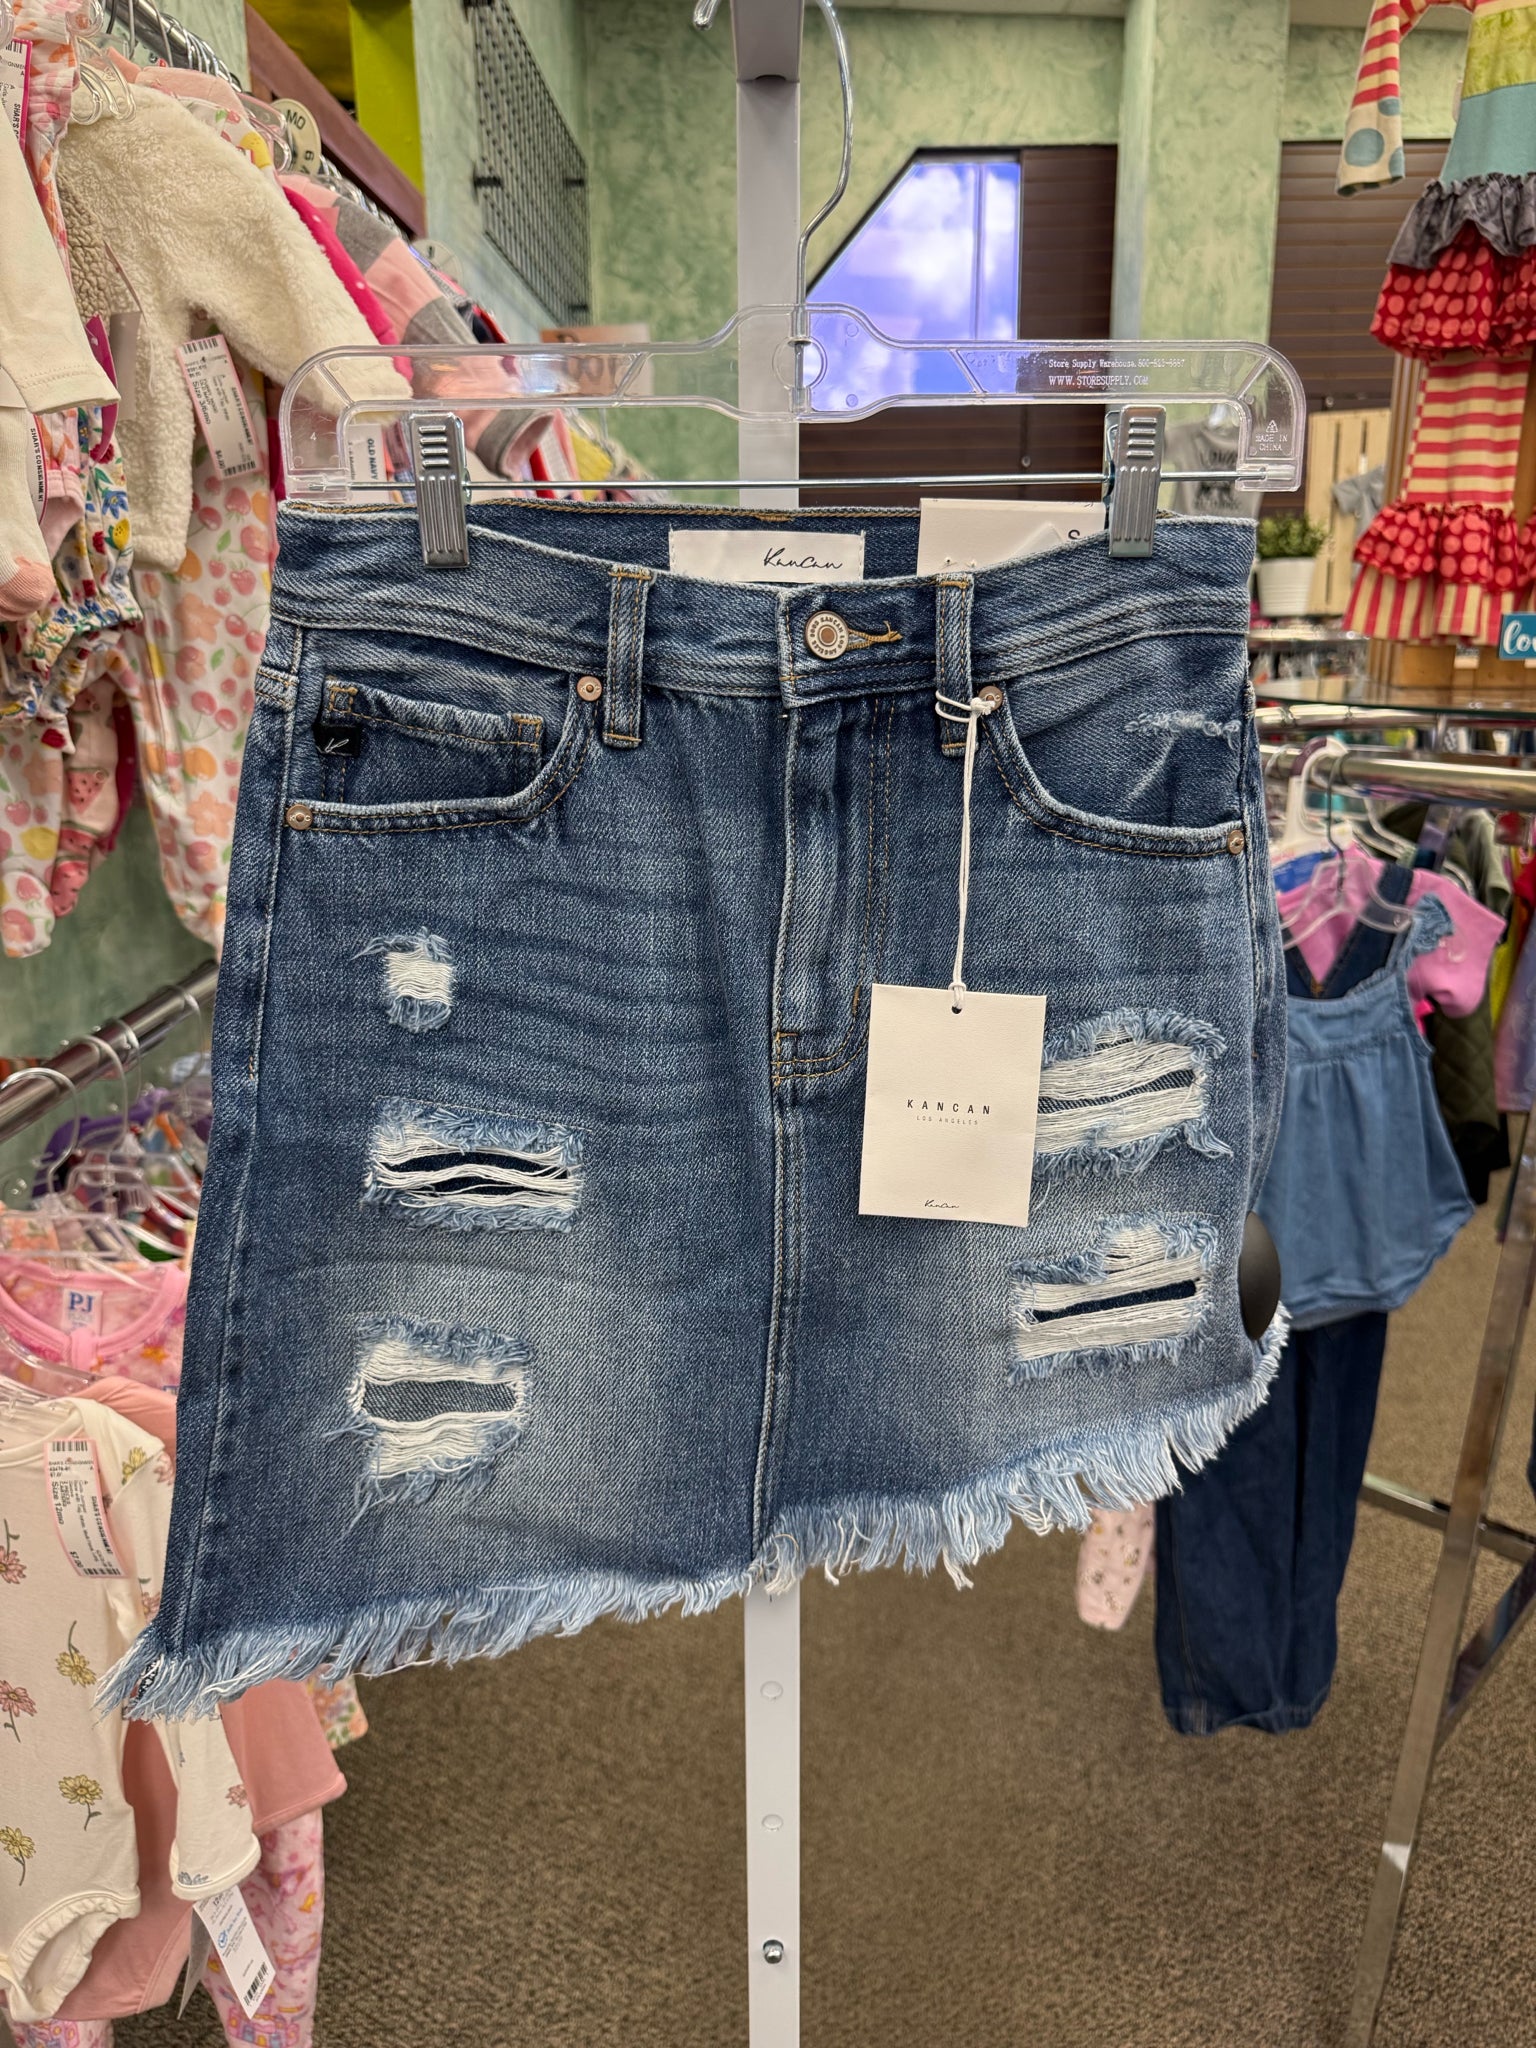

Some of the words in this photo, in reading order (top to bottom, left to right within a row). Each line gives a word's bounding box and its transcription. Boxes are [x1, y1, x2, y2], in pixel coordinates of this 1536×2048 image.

[12, 103, 21, 128] SHAR'S
[1049, 359, 1070, 368] Store
[1072, 359, 1097, 369] Supply
[367, 438, 376, 456] OLD
[369, 457, 378, 480] NAVY
[907, 1099, 990, 1114] KANCAN
[939, 1117, 978, 1125] ANGELES
[69, 1291, 95, 1312] PJ
[52, 1481, 60, 1500] Size
[55, 1503, 64, 1525] 12mo
